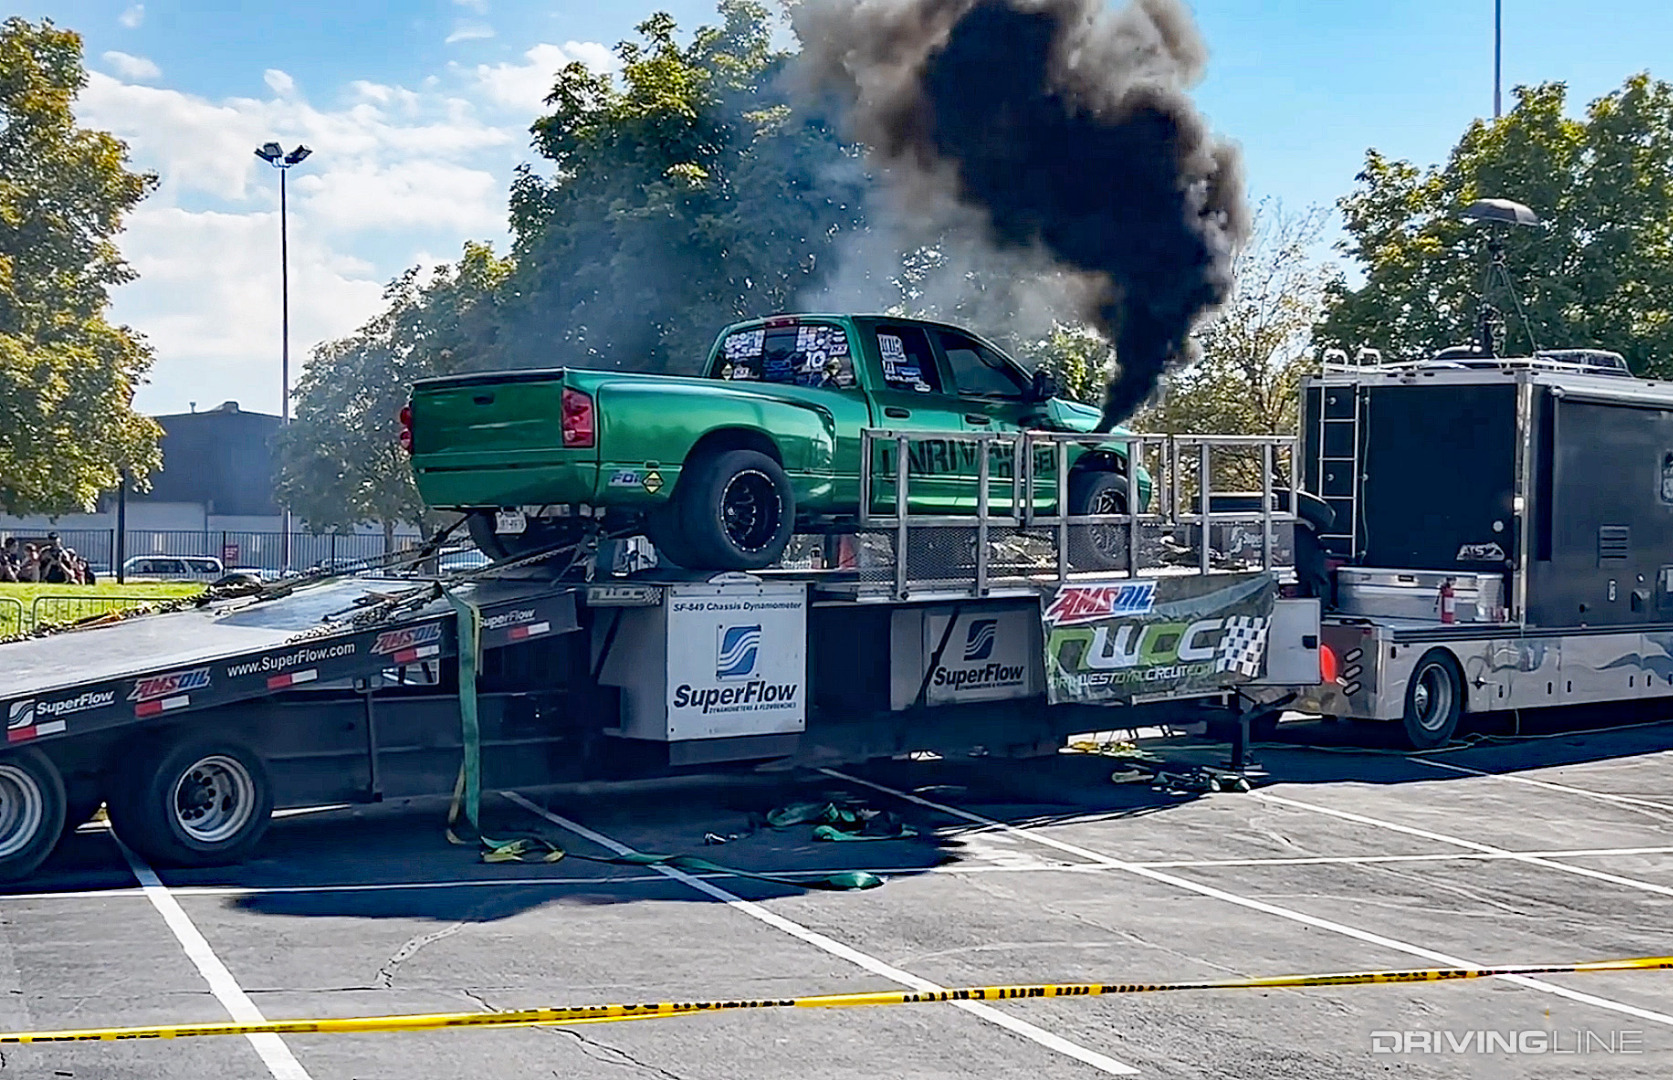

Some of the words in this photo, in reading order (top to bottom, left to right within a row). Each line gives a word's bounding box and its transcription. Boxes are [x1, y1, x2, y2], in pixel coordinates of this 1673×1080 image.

[478, 608, 536, 629] SuperFlow
[706, 601, 741, 611] Chassis
[743, 601, 802, 612] Dynamometer
[1044, 582, 1156, 624] AMSOIL
[371, 622, 442, 655] AMSOIL
[226, 642, 356, 678] www.SuperFlow.com
[126, 667, 211, 702] AMSOIL
[933, 663, 1025, 691] SuperFlow
[36, 690, 115, 715] SuperFlow
[673, 681, 798, 714] SuperFlow
